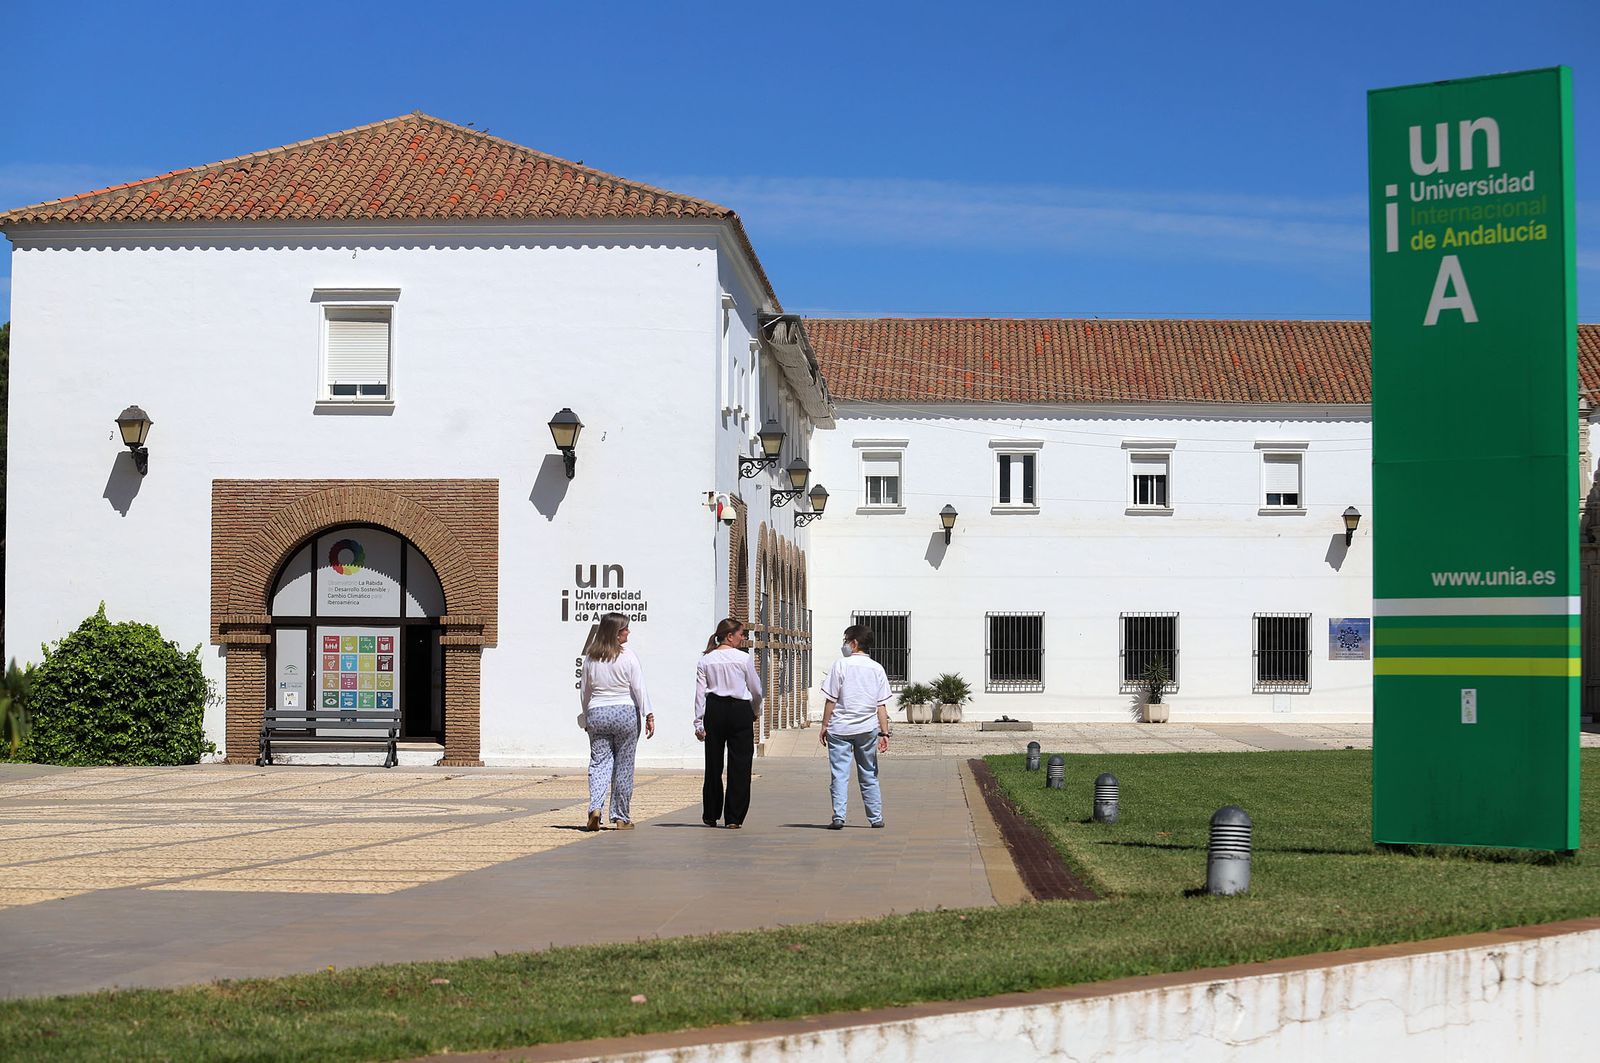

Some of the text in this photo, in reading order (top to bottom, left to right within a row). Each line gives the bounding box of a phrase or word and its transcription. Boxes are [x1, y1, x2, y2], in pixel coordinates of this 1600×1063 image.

[1409, 117, 1501, 176] un
[1410, 170, 1535, 202] Universidad
[1385, 184, 1400, 253] i
[1410, 195, 1547, 226] Internacional
[1410, 220, 1548, 251] de Andalucía
[1422, 254, 1479, 327] A
[575, 563, 624, 588] un
[1431, 566, 1556, 587] www.unia.es
[562, 590, 569, 621] i
[575, 590, 642, 600] Universidad
[575, 601, 648, 611] Internacional
[575, 612, 589, 622] de
